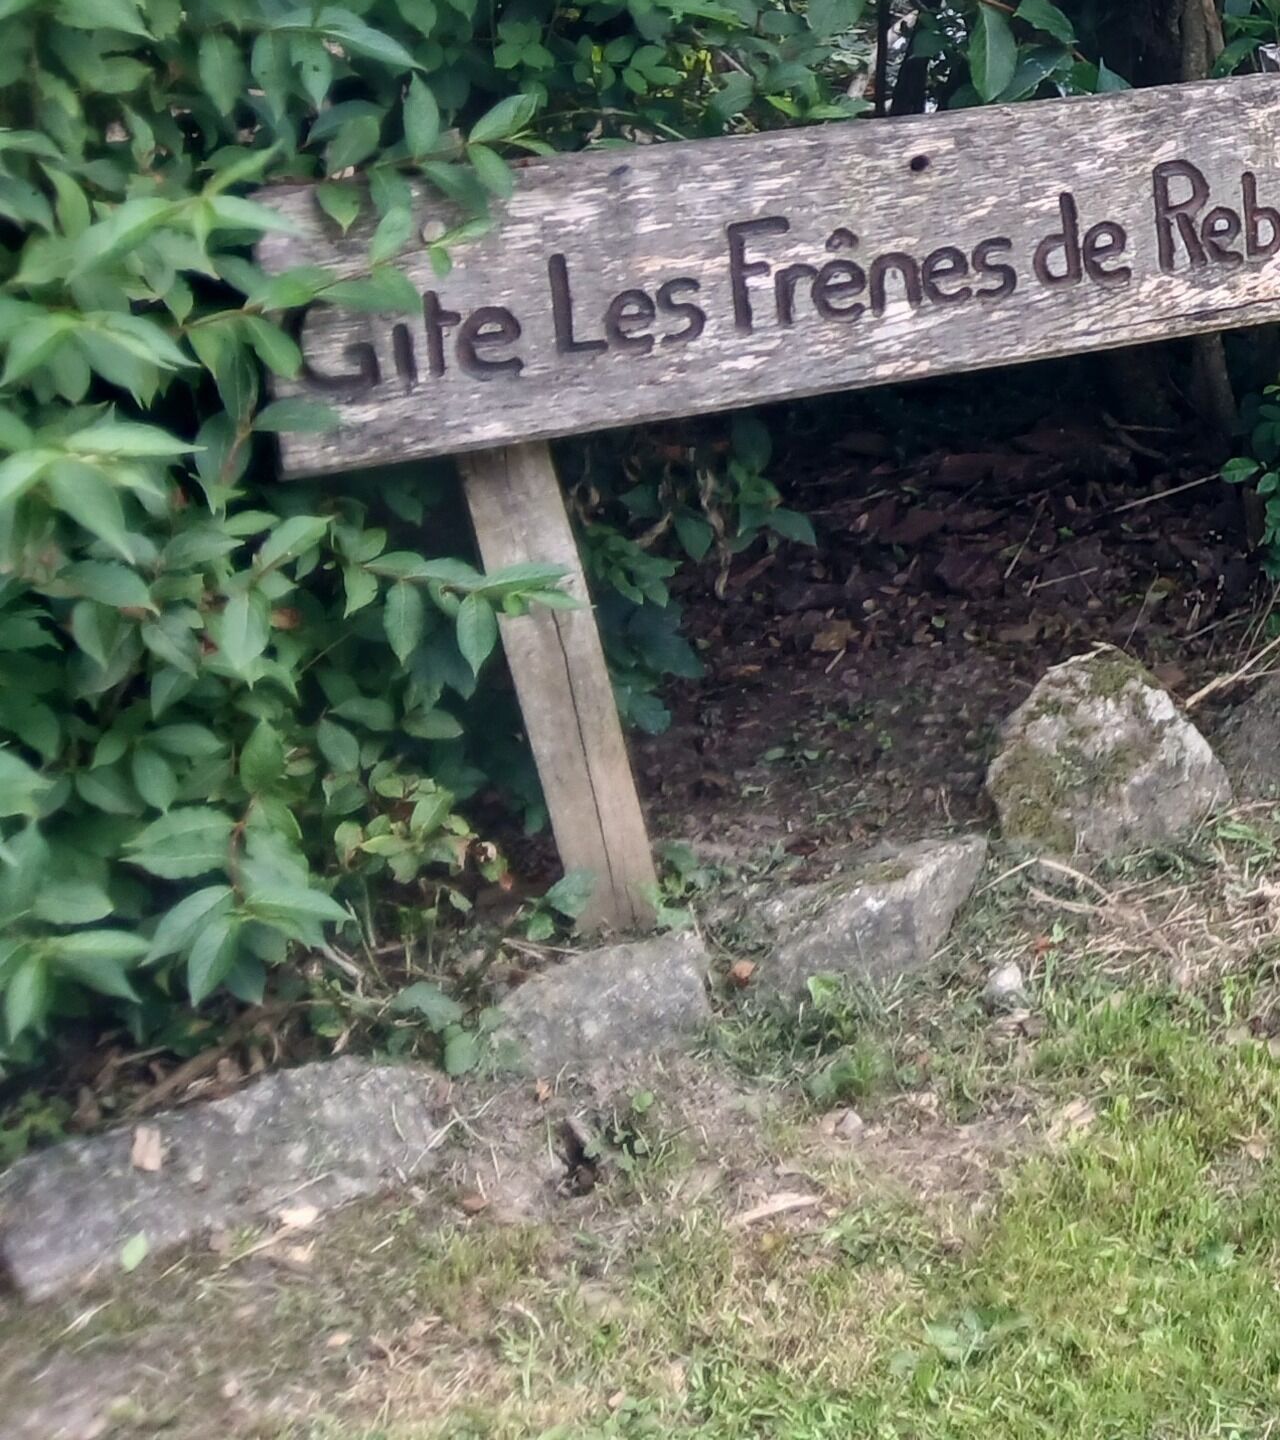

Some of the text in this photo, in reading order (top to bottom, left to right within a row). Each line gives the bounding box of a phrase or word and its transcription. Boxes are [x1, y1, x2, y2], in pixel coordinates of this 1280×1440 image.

[547, 254, 706, 355] Les
[726, 215, 1018, 328] Frênes
[1033, 192, 1132, 286] de
